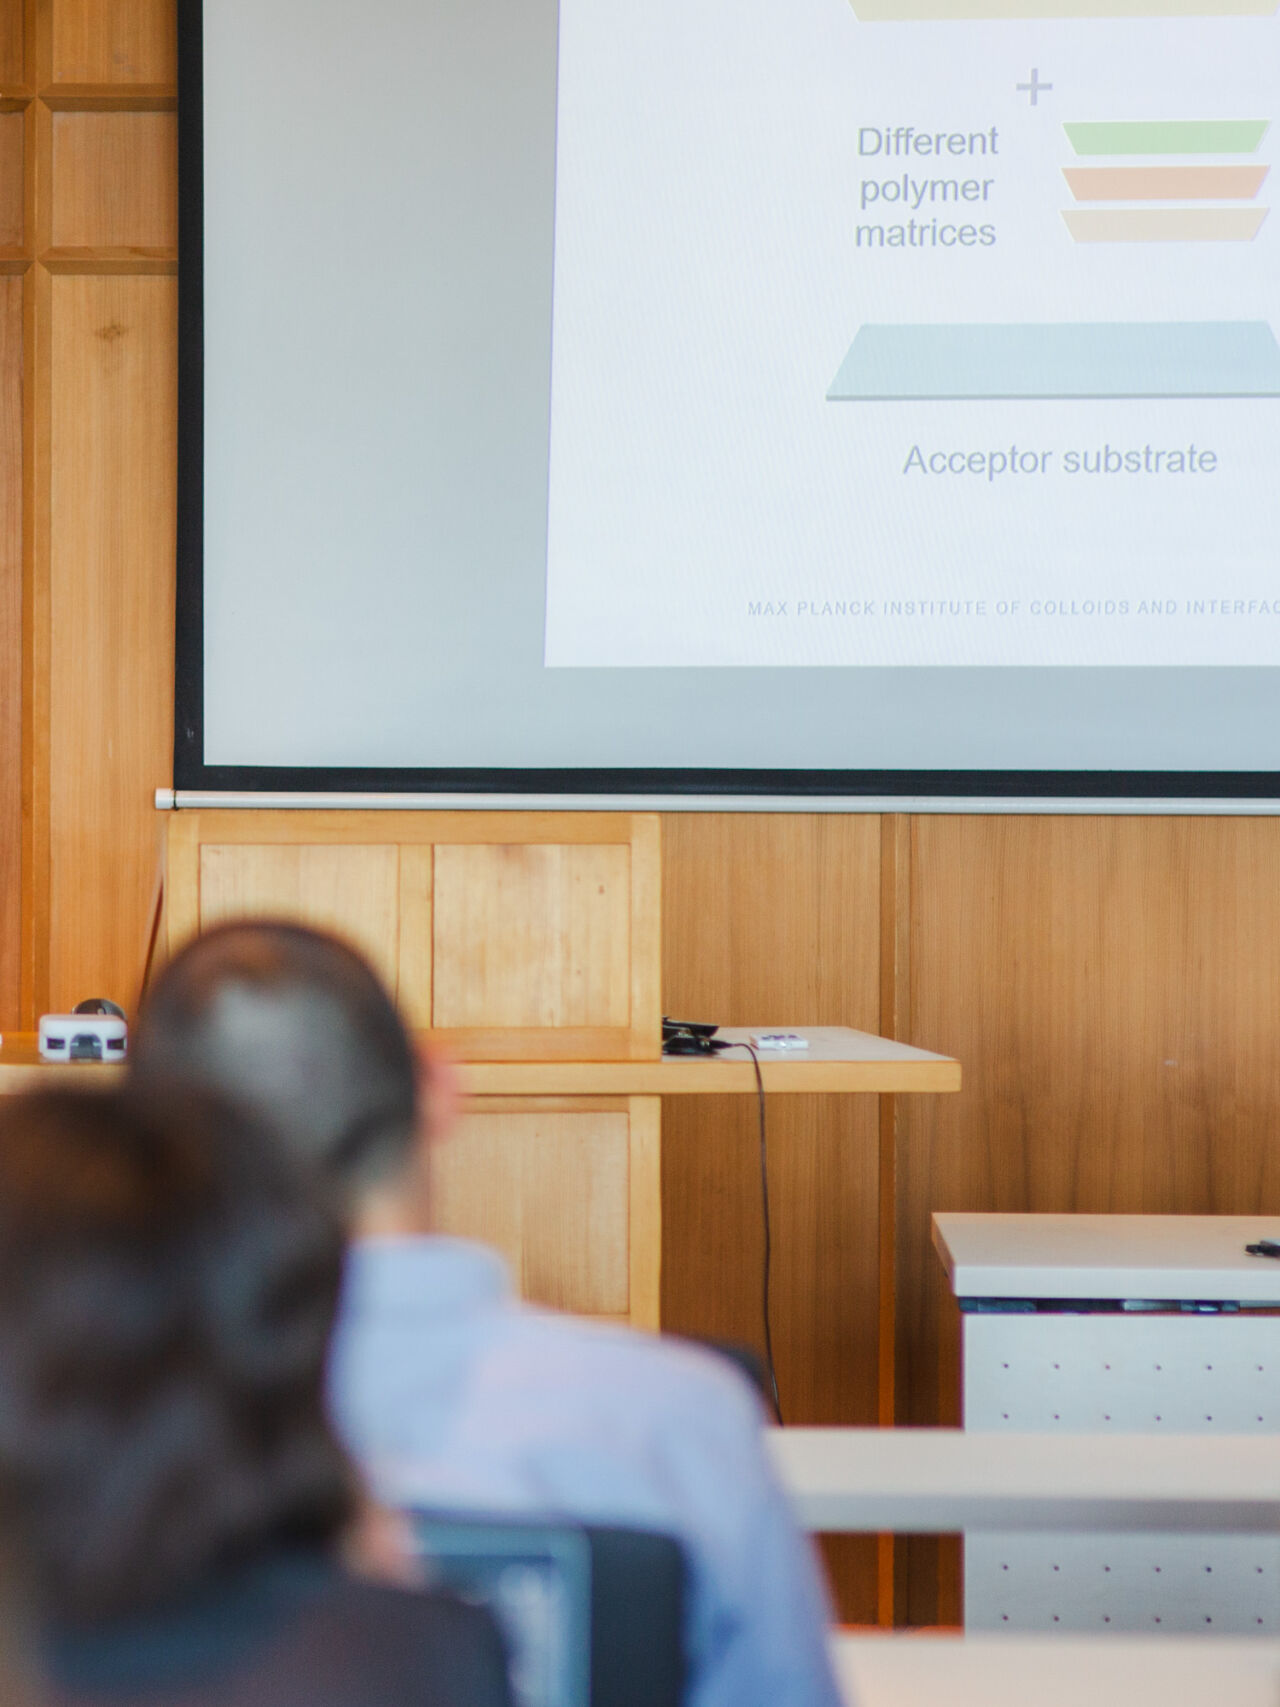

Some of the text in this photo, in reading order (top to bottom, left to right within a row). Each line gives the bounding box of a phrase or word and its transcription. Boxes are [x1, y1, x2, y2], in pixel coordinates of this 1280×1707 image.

[858, 126, 999, 157] Different
[861, 173, 995, 210] polymer
[856, 217, 996, 247] matrices
[902, 444, 1218, 481] Acceptor substrate
[748, 601, 787, 616] MAX
[797, 601, 875, 616] PLANCK
[883, 601, 986, 616] INSTITUTE
[996, 601, 1020, 616] OF
[1030, 600, 1129, 615] COLLOIDS
[1137, 600, 1177, 615] AND
